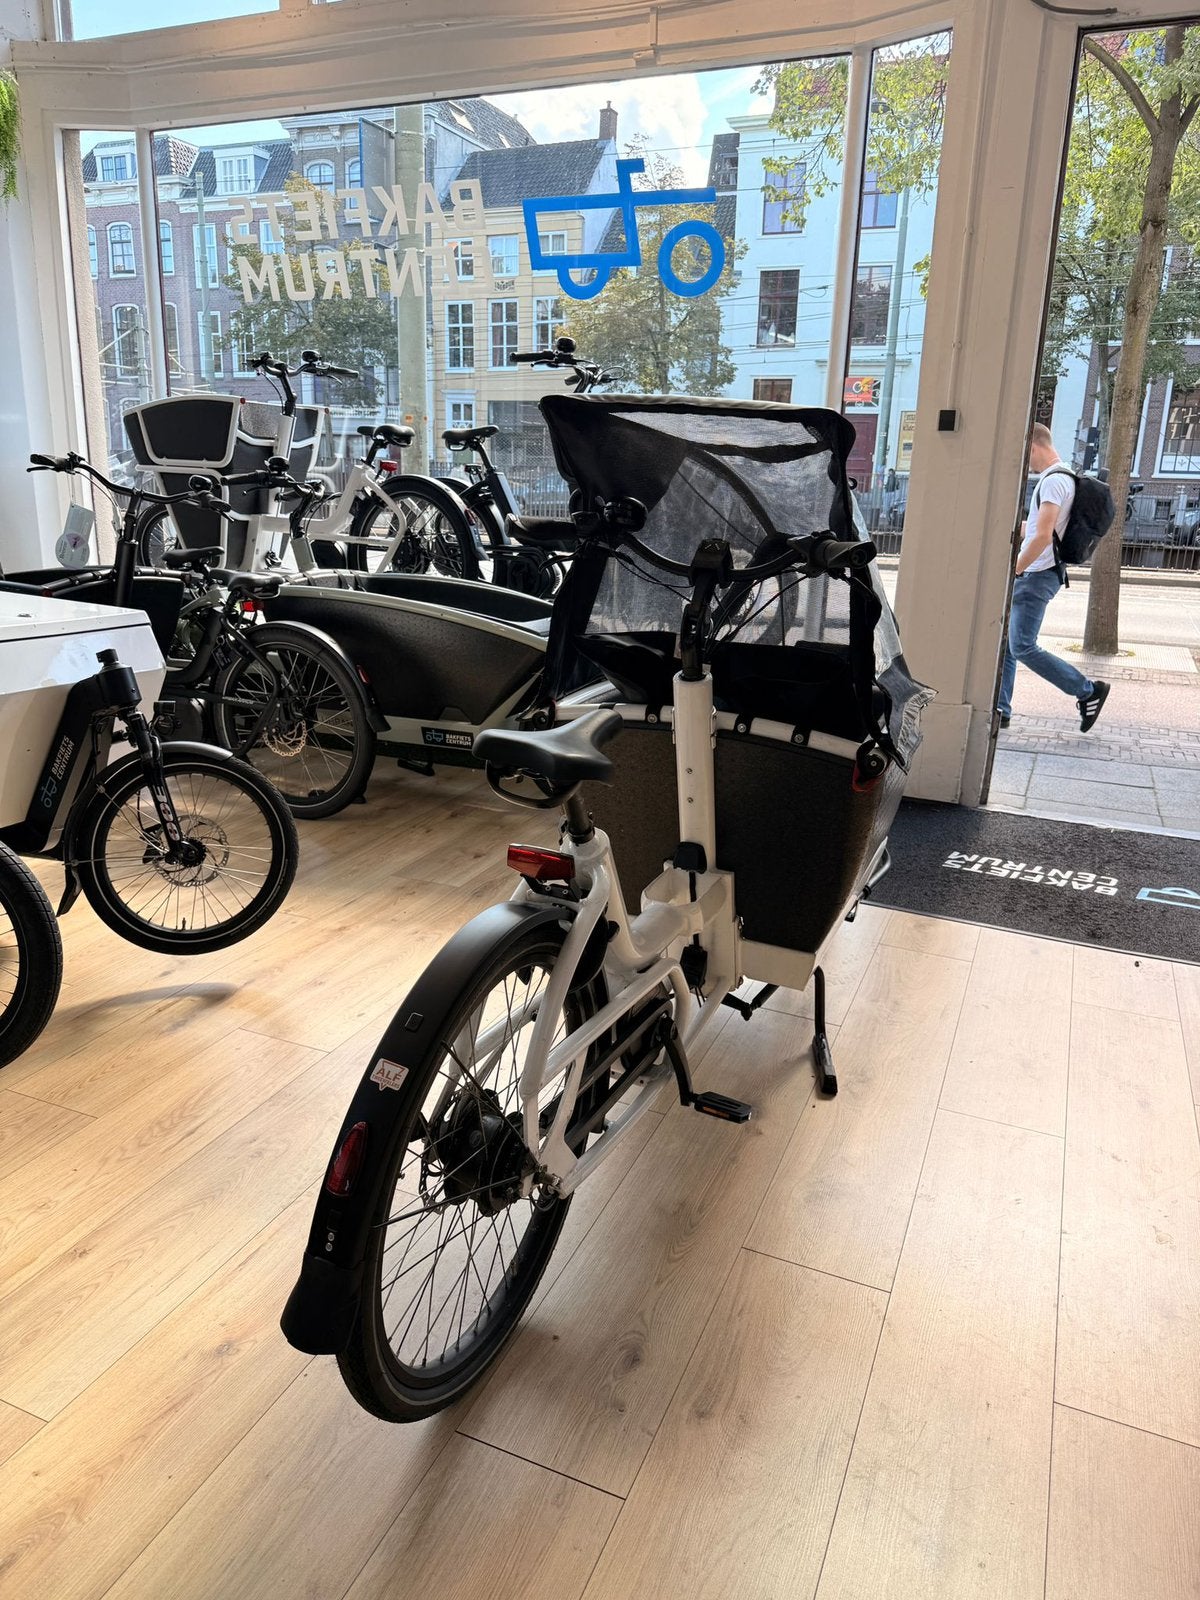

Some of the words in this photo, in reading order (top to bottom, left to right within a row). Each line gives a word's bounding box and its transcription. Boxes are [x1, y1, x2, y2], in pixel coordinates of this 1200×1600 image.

[51, 735, 70, 775] BAKFIETS
[445, 733, 472, 742] BAKFIETS
[446, 738, 472, 746] CENTRUM
[56, 740, 75, 780] CENTRUM
[942, 860, 1119, 896] BAKFIETS
[947, 851, 1119, 887] CENTRUM
[375, 1067, 402, 1082] ALF
